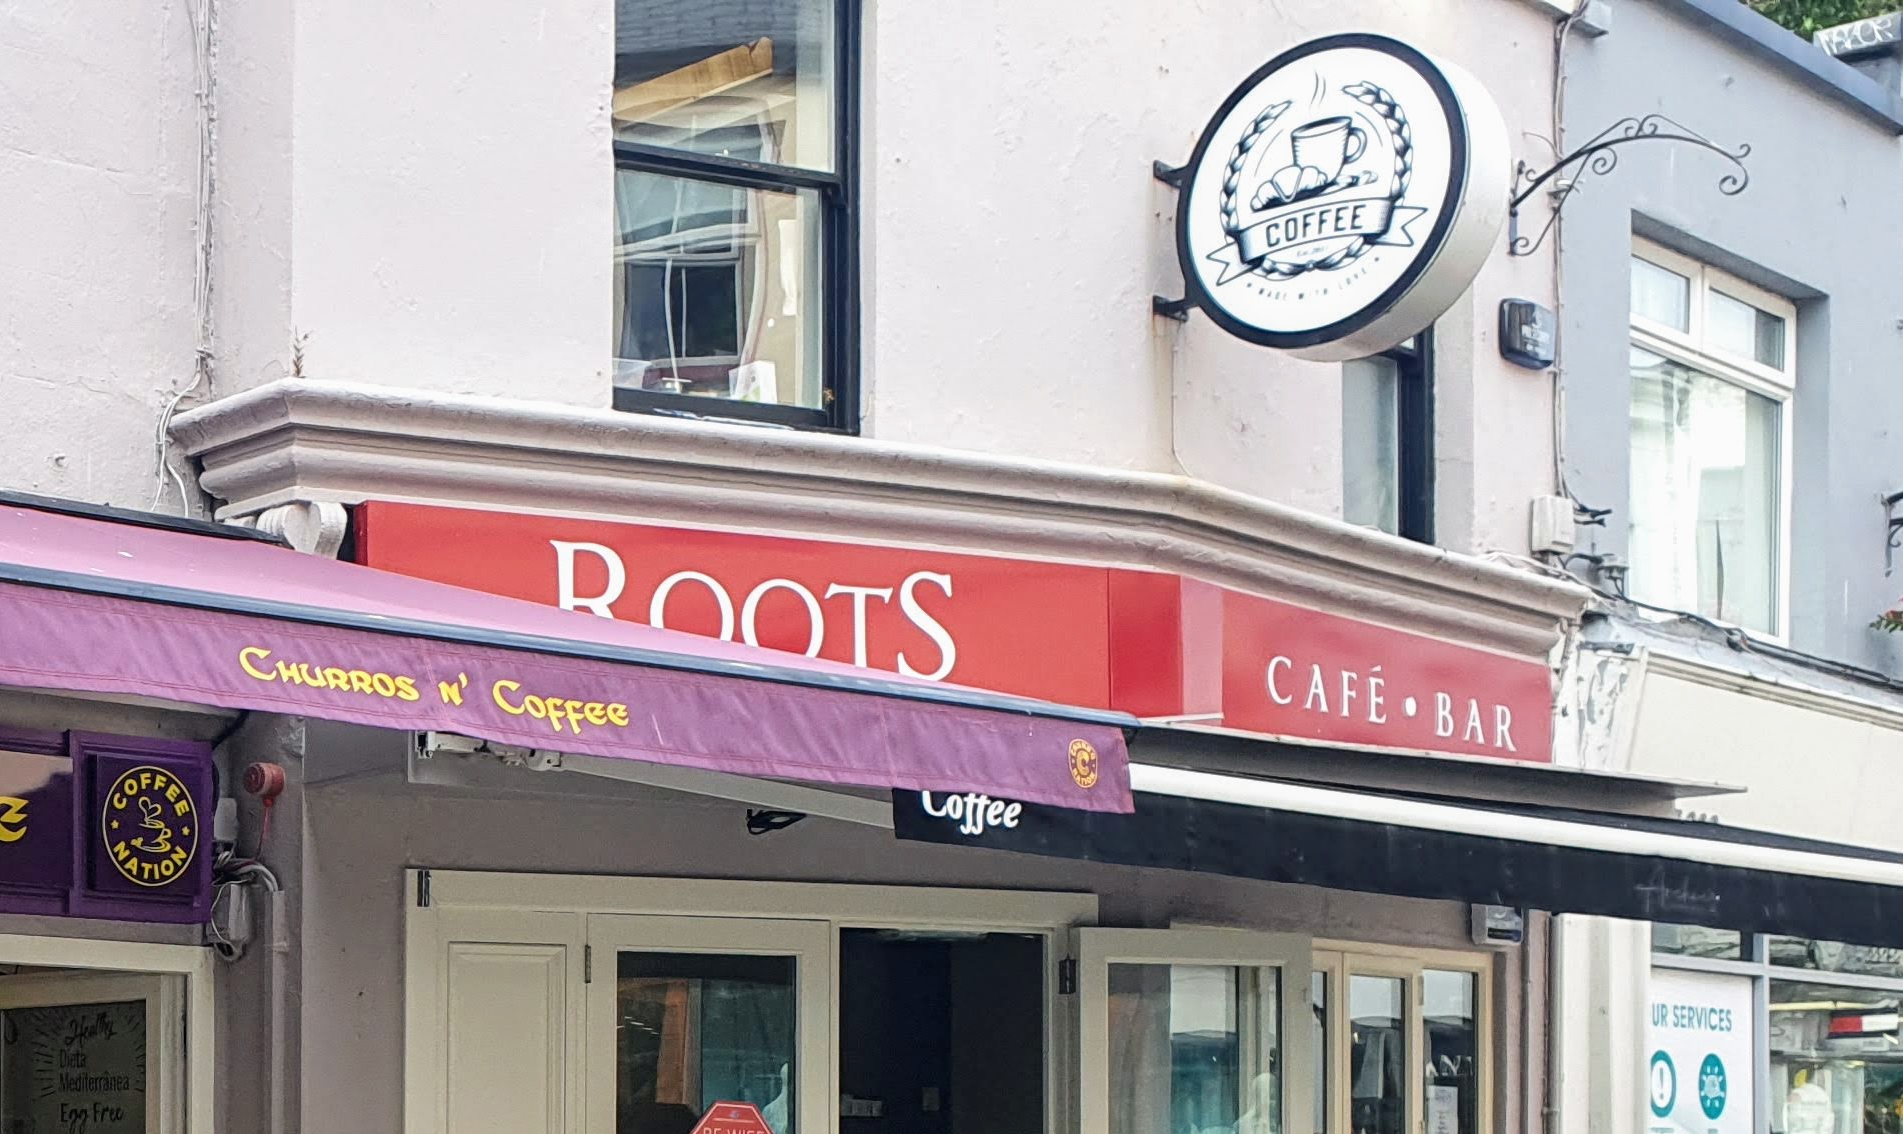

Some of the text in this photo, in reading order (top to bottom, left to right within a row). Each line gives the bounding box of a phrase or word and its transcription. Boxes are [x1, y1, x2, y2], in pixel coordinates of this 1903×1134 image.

[1265, 204, 1367, 247] COFFEE
[549, 540, 957, 681] ROOTS
[1267, 655, 1517, 752] CAFÉ BAR
[111, 770, 191, 818] COFFEE
[922, 791, 1022, 835] Coffee
[111, 839, 190, 882] NATION
[65, 1012, 117, 1048] Healthy
[1652, 1003, 1732, 1032] UR SERVICES
[59, 1049, 86, 1068] Dieta
[93, 1102, 123, 1122] Free
